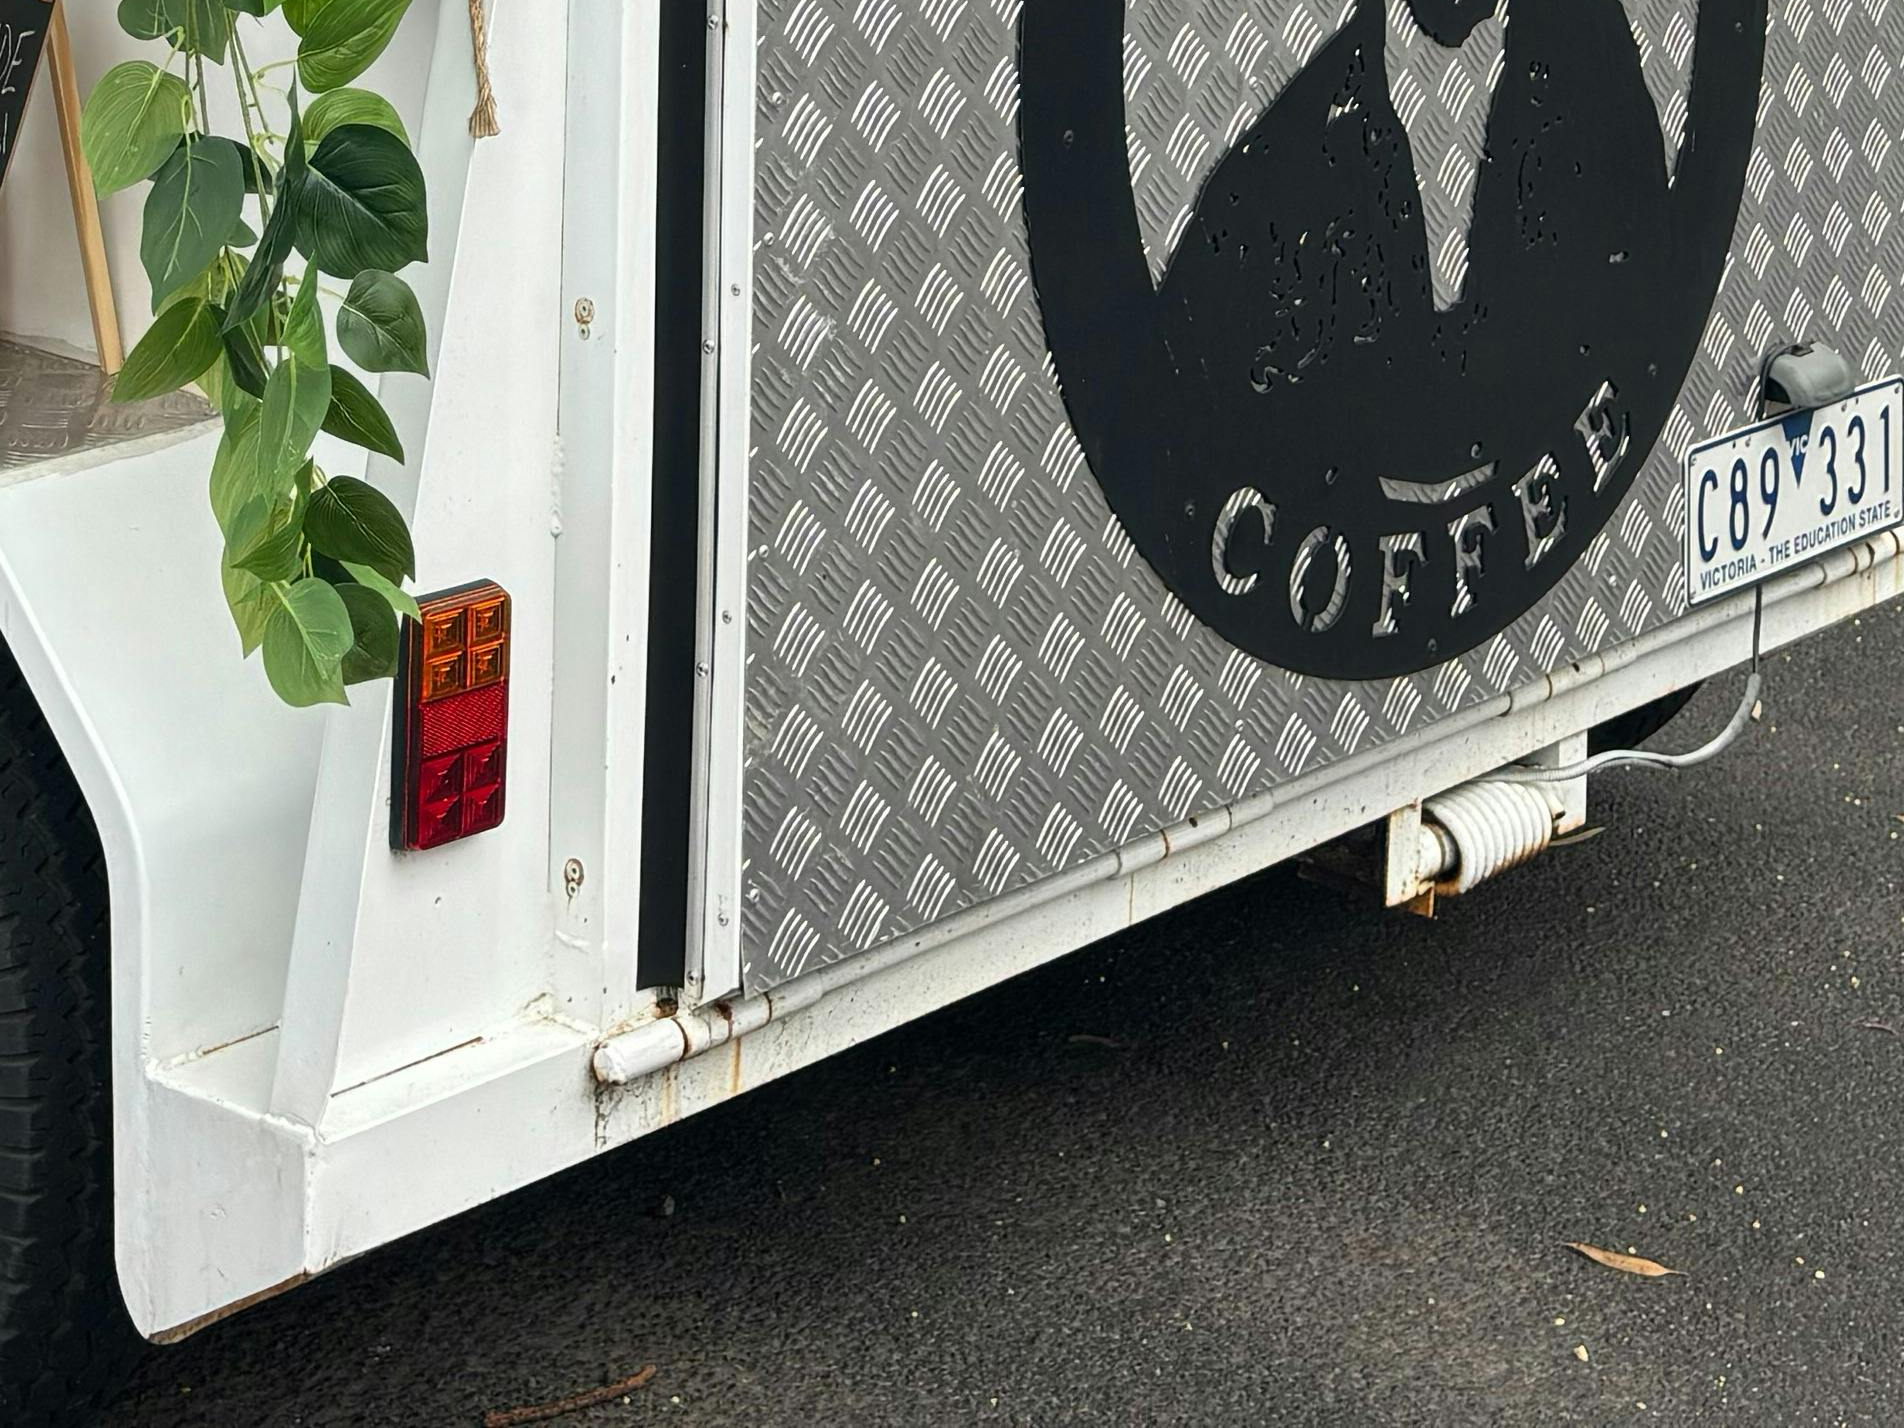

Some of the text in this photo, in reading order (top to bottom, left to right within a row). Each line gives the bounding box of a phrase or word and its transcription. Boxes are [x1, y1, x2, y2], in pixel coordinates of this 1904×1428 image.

[1211, 380, 1631, 638] COFFEE
[1697, 404, 1891, 563] C89 331
[1700, 553, 1758, 591] VICTORIA
[1768, 542, 1791, 565] THE
[1795, 516, 1857, 554] EDUCATION
[1858, 499, 1892, 529] STATE
